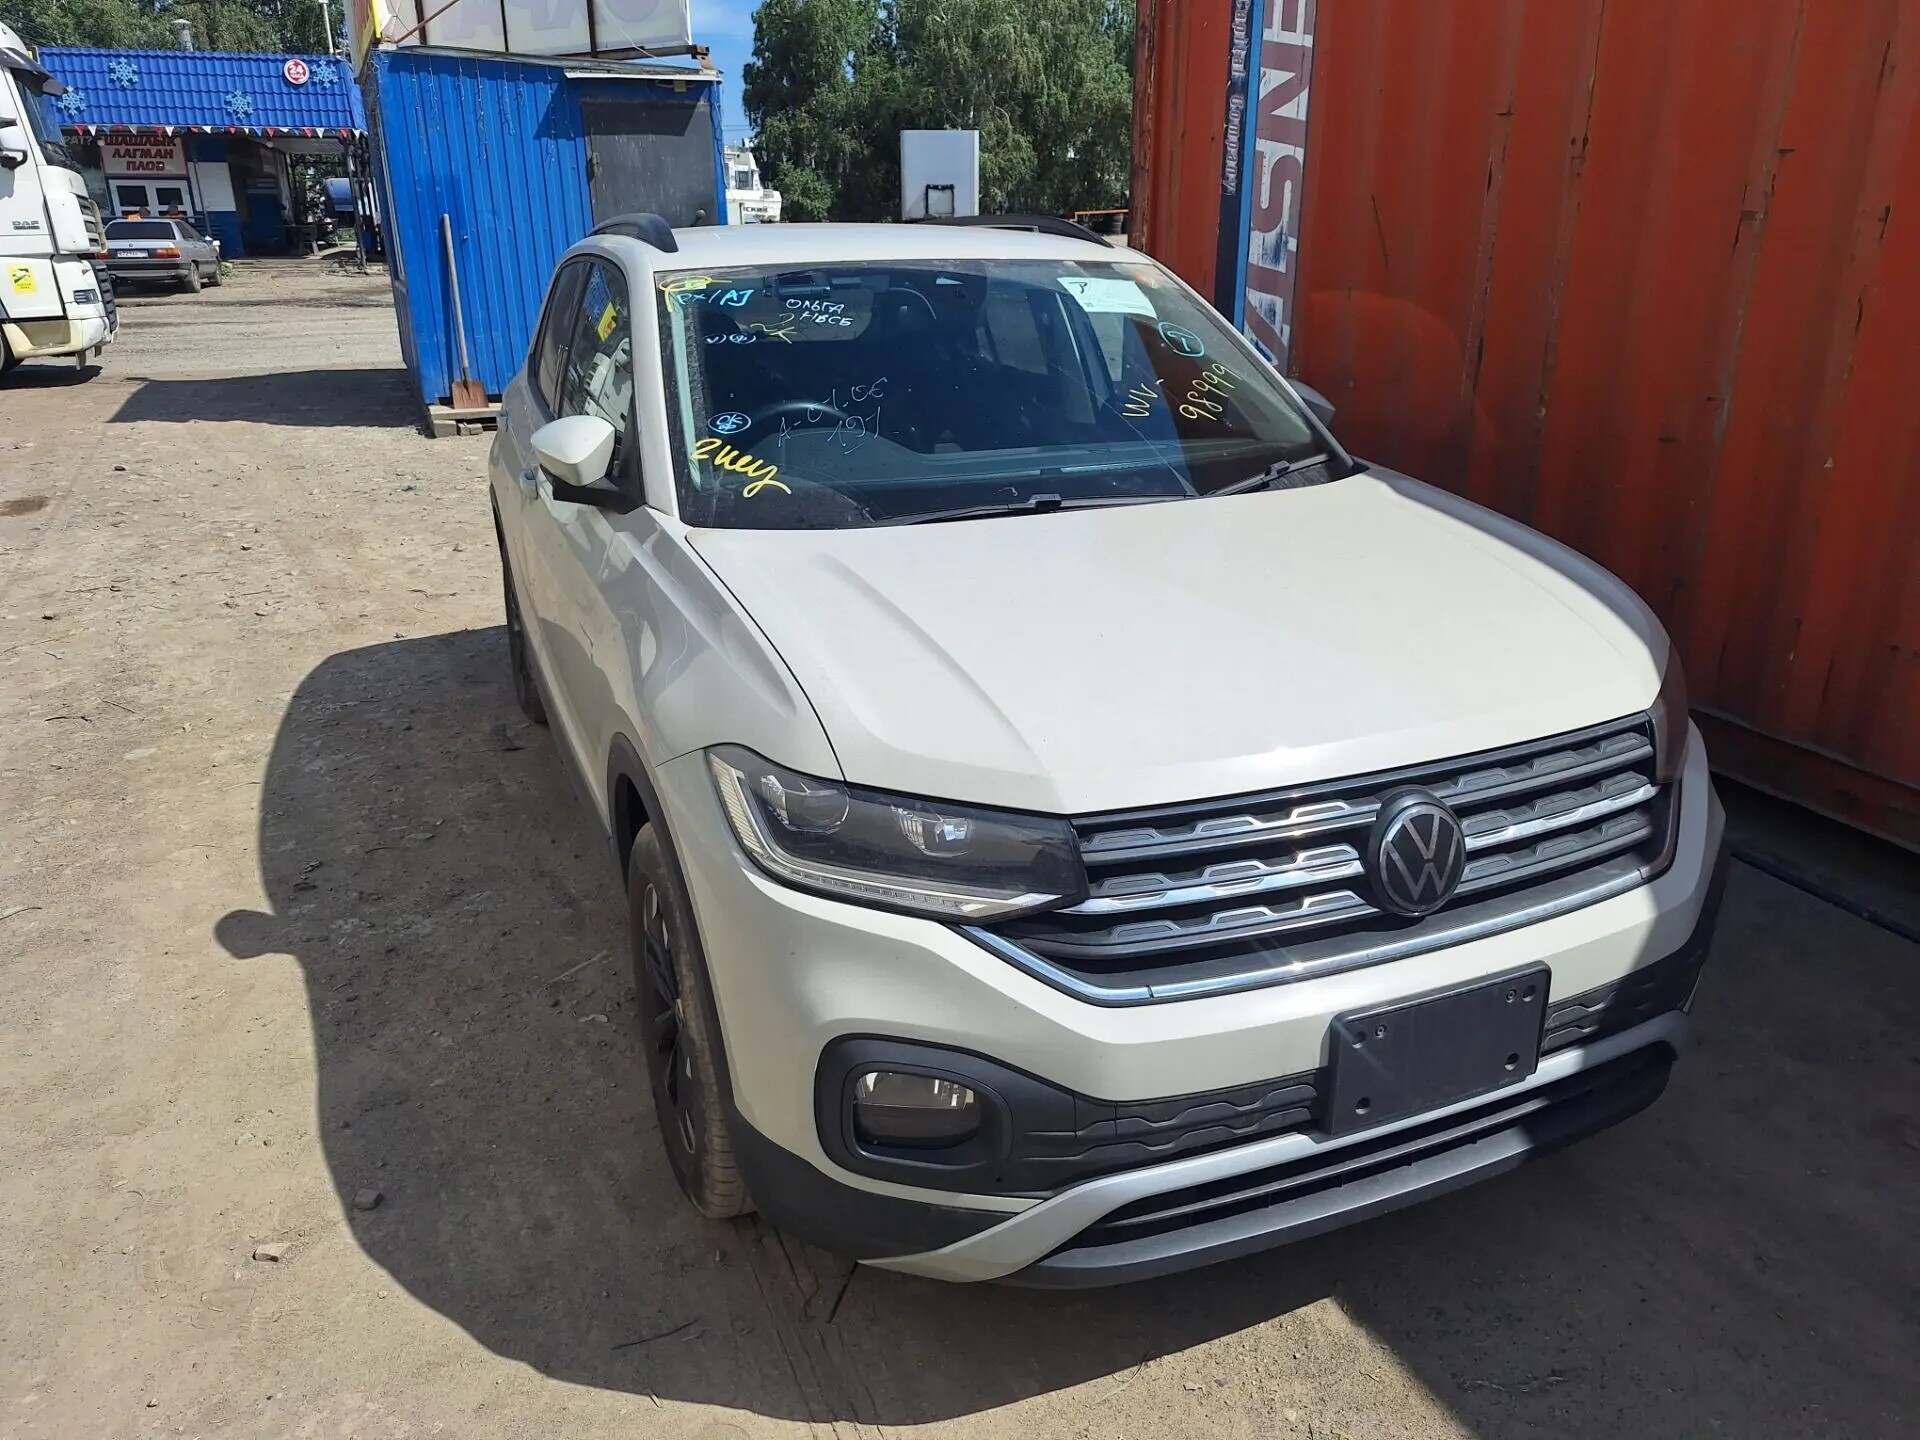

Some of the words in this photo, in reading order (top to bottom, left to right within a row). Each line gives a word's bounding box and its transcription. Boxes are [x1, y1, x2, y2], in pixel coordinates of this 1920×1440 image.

[112, 147, 174, 159] ЛАГМАН
[1222, 94, 1245, 196] Company
[690, 438, 723, 460] 2
